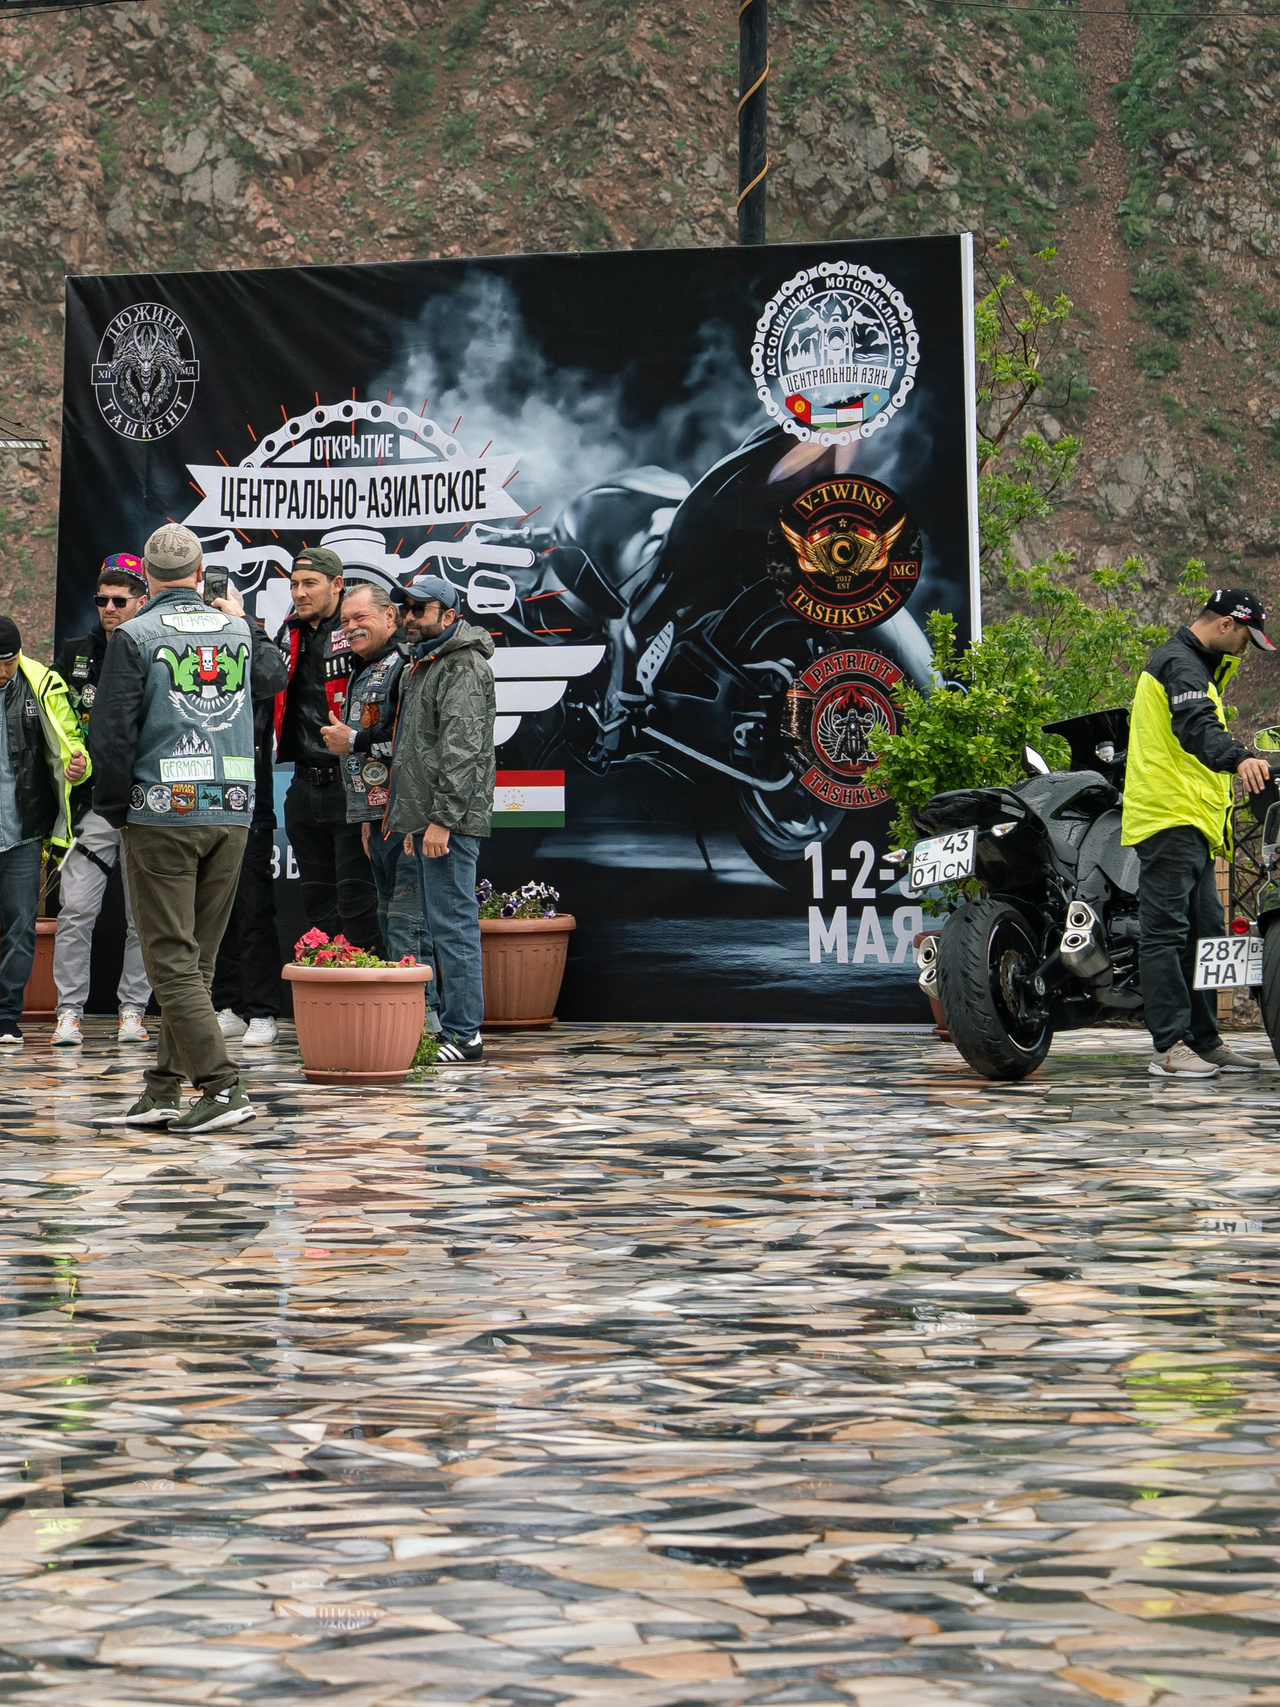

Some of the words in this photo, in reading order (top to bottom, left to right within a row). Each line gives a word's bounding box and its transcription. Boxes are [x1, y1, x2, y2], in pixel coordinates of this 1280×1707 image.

[106, 305, 185, 343] ДЮЖИНА
[767, 283, 815, 376] АССОЦИАЦИЯ
[825, 277, 905, 367] МОТОЦИКЛИСТОВ
[786, 364, 860, 393] ЦЕНТРАЛЬНОЙ
[861, 366, 888, 387] АЗИИ
[102, 397, 188, 438] ТАШКЕНТ
[313, 433, 394, 461] ОТКРЫТИЕ
[220, 467, 487, 523] ЦЕНТРАЛЬНО-АЗИАТСКОЕ
[799, 483, 886, 511] V-TWINS
[835, 575, 852, 583] 2017
[892, 564, 915, 577] MC
[793, 587, 895, 625] TASHKENT
[811, 654, 893, 683] PATRIOT
[162, 759, 212, 778] GERMANIA
[942, 831, 970, 854] 43
[915, 852, 929, 863] KZ
[913, 864, 937, 886] 01
[943, 859, 970, 879] CN
[808, 905, 924, 964] МАЯ
[1200, 939, 1246, 962] 287
[1203, 963, 1237, 985] HA
